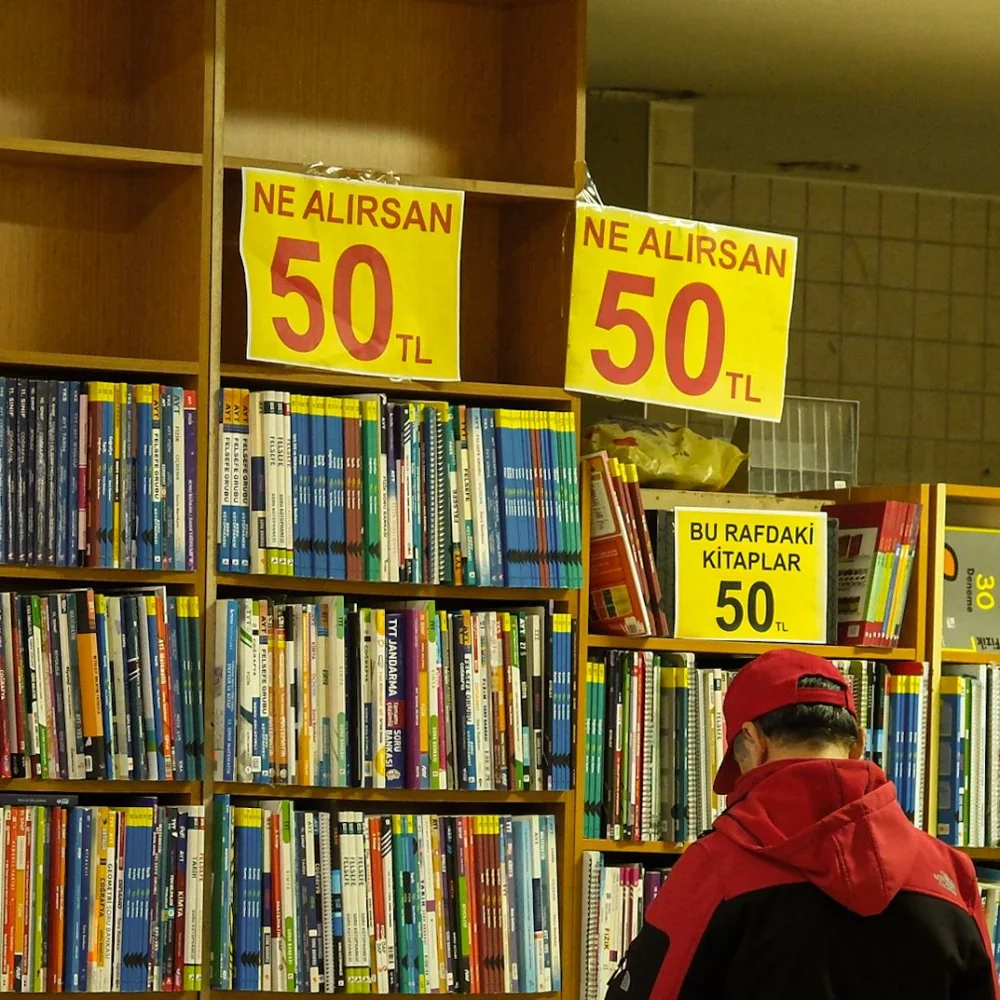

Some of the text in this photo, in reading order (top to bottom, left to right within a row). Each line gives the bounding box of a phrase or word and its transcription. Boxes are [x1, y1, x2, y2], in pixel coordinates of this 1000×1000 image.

[254, 182, 452, 234] NE ALIRSAN
[583, 216, 787, 278] NE ALIRSAN
[271, 236, 432, 364] 50 TL
[590, 269, 761, 403] 50 TL
[690, 522, 814, 545] BU RAFDAKİ
[703, 546, 801, 571] KİTAPLAR
[716, 580, 788, 632] 50 TL
[976, 574, 995, 610] 30
[388, 619, 397, 696] TYT JANDARMA
[385, 731, 393, 767] BANKASI
